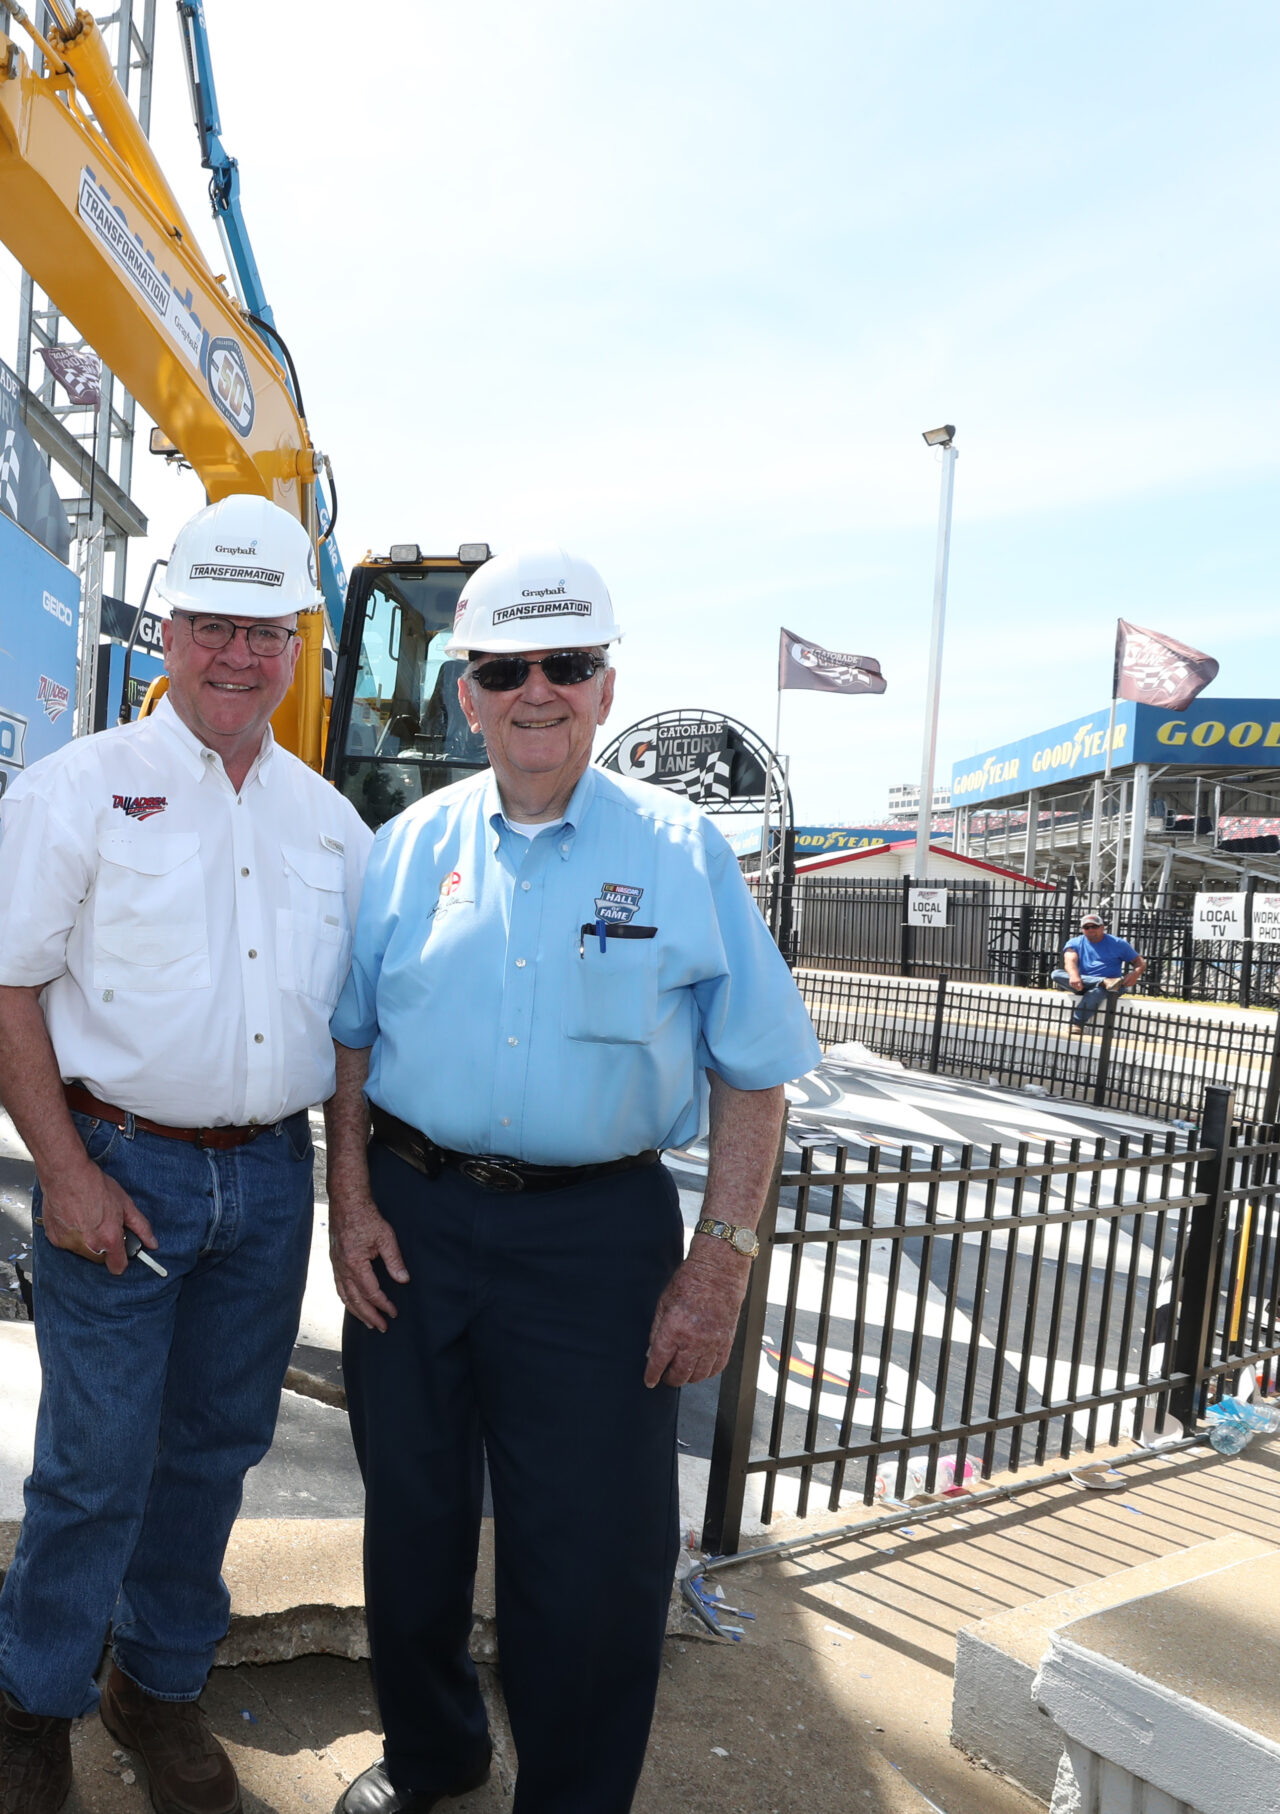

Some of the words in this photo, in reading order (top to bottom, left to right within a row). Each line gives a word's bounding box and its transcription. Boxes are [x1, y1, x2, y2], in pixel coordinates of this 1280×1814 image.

[85, 190, 169, 308] TRANSFORMATION
[217, 353, 245, 417] 50
[193, 567, 282, 583] TRANSFORMATION
[42, 590, 72, 627] GEICO
[496, 602, 590, 622] TRANSFORMATION
[658, 722, 724, 738] GATORADE
[658, 736, 721, 756] VICTORY
[658, 755, 697, 773] LANE
[606, 893, 635, 905] HALL
[600, 908, 629, 921] FAME
[913, 902, 942, 913] LOCAL
[921, 914, 933, 924] TV
[1200, 910, 1238, 923] LOCAL
[1211, 925, 1226, 937] TV
